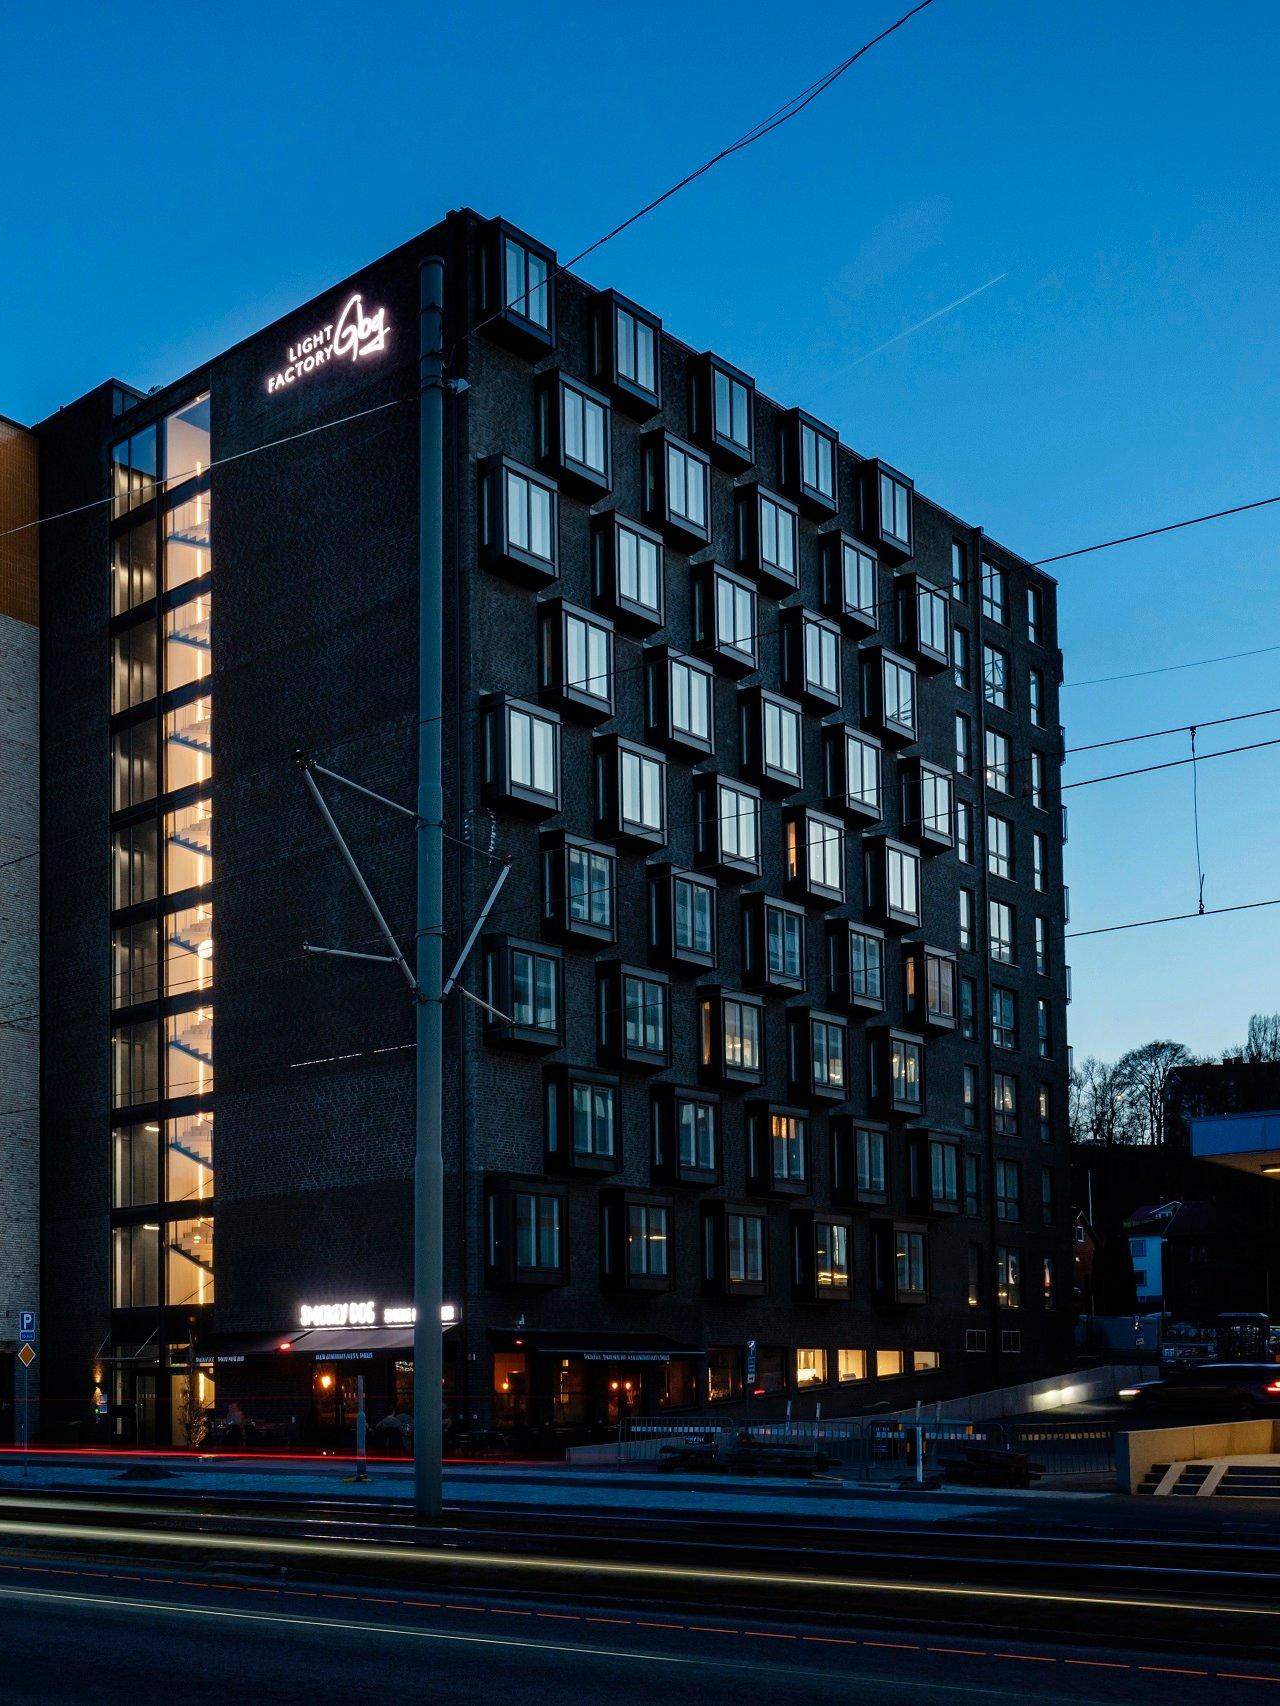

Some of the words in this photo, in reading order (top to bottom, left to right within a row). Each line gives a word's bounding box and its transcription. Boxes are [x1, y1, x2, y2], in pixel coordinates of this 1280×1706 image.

[288, 324, 334, 363] LIGHT
[332, 294, 391, 362] Gbg
[266, 343, 335, 394] FACTORY
[23, 1313, 32, 1330] P
